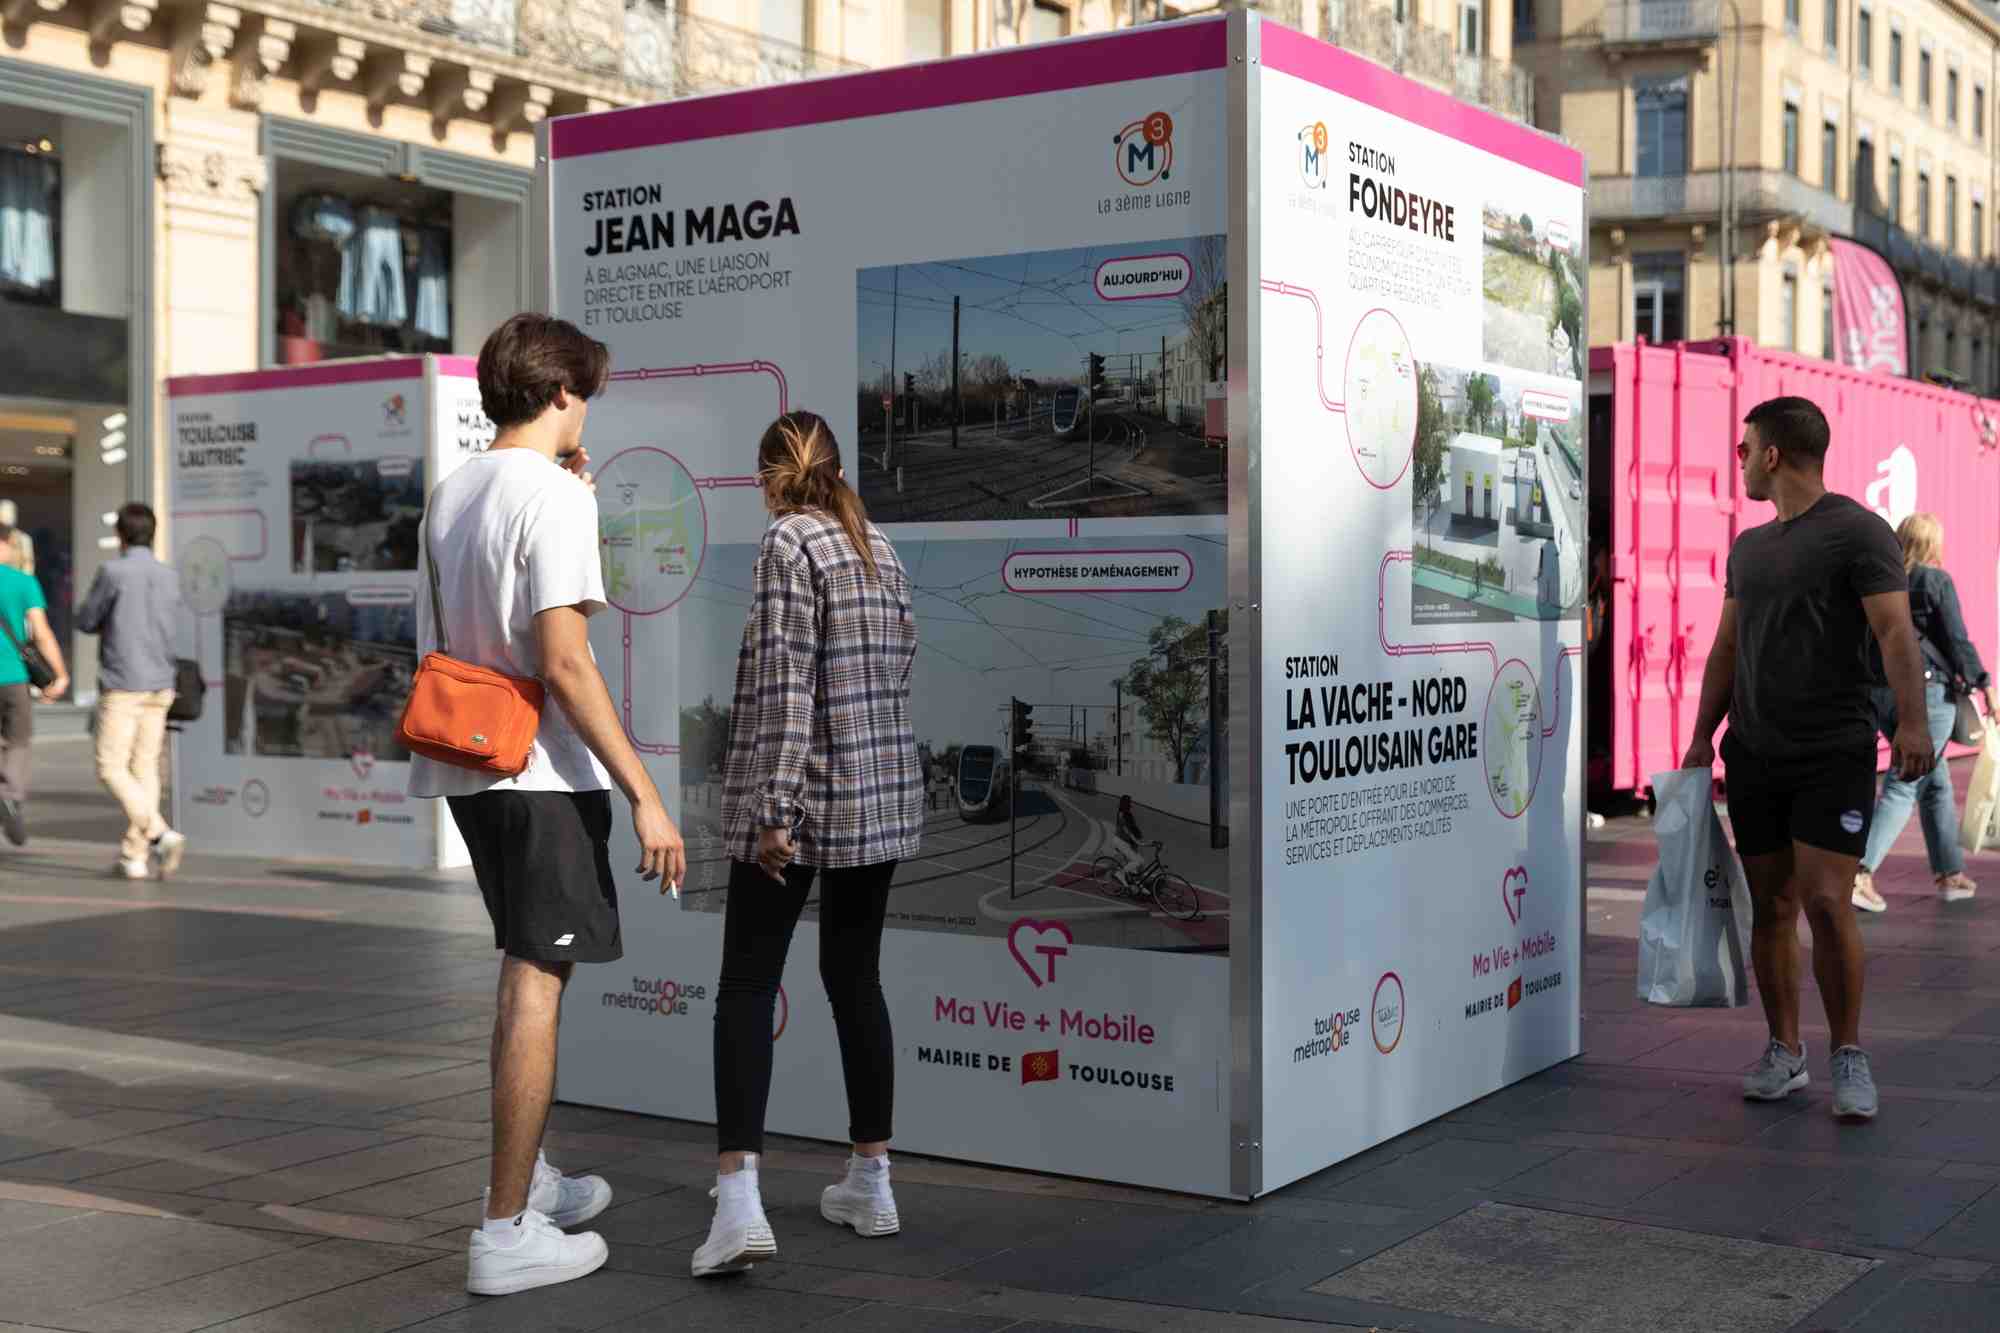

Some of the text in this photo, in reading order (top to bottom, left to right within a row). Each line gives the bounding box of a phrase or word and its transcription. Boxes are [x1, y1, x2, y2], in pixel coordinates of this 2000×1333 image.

[1349, 141, 1395, 177] STATION
[583, 184, 662, 212] STATION
[1349, 172, 1455, 242] FONDEYRE
[584, 197, 801, 257] JEAN MAGA
[598, 261, 672, 284] BLAGNAC,
[676, 257, 705, 277] UNE
[710, 251, 769, 273] LIAISON
[1103, 269, 1182, 287] AUJOURD'HUI
[585, 270, 792, 305] DIRECTE ENTRE L'AÉROPORT
[585, 301, 682, 325] ET TOULOUSE
[1014, 563, 1180, 579] HYPOTHÈSE D'AMÉNAGEMENT
[1286, 655, 1338, 679] STATION
[1286, 688, 1316, 731] LA
[1321, 681, 1393, 727] VACHE
[1412, 676, 1467, 717] NORD
[1285, 722, 1478, 785] TOULOUSAIN GARE
[1286, 799, 1306, 819] UNE
[1309, 793, 1339, 815] PORTE
[1384, 783, 1408, 802] POUR
[1409, 780, 1419, 799] LE
[1420, 777, 1444, 795] NORD
[1445, 774, 1456, 792] DE
[1286, 823, 1297, 842] LA
[1360, 806, 1398, 828] OFFRANT
[1400, 802, 1416, 822] DES
[1286, 840, 1332, 866] SERVICES
[1333, 837, 1344, 856] ET
[1472, 952, 1490, 979] Ma
[1492, 945, 1510, 971] Vie
[1521, 929, 1556, 961] Mobile
[602, 990, 688, 1016] métropole
[633, 976, 706, 1000] toulouse
[1465, 971, 1562, 1020] MAIRIE DE TOULOUSE
[935, 996, 975, 1026] Ma
[984, 1001, 1025, 1031] Vie
[1060, 1008, 1155, 1045] Mobile
[1314, 1008, 1361, 1036] toulouse
[1293, 1030, 1350, 1063] métropole
[918, 1047, 1174, 1092] MAIRIE DE TOULOUSE
